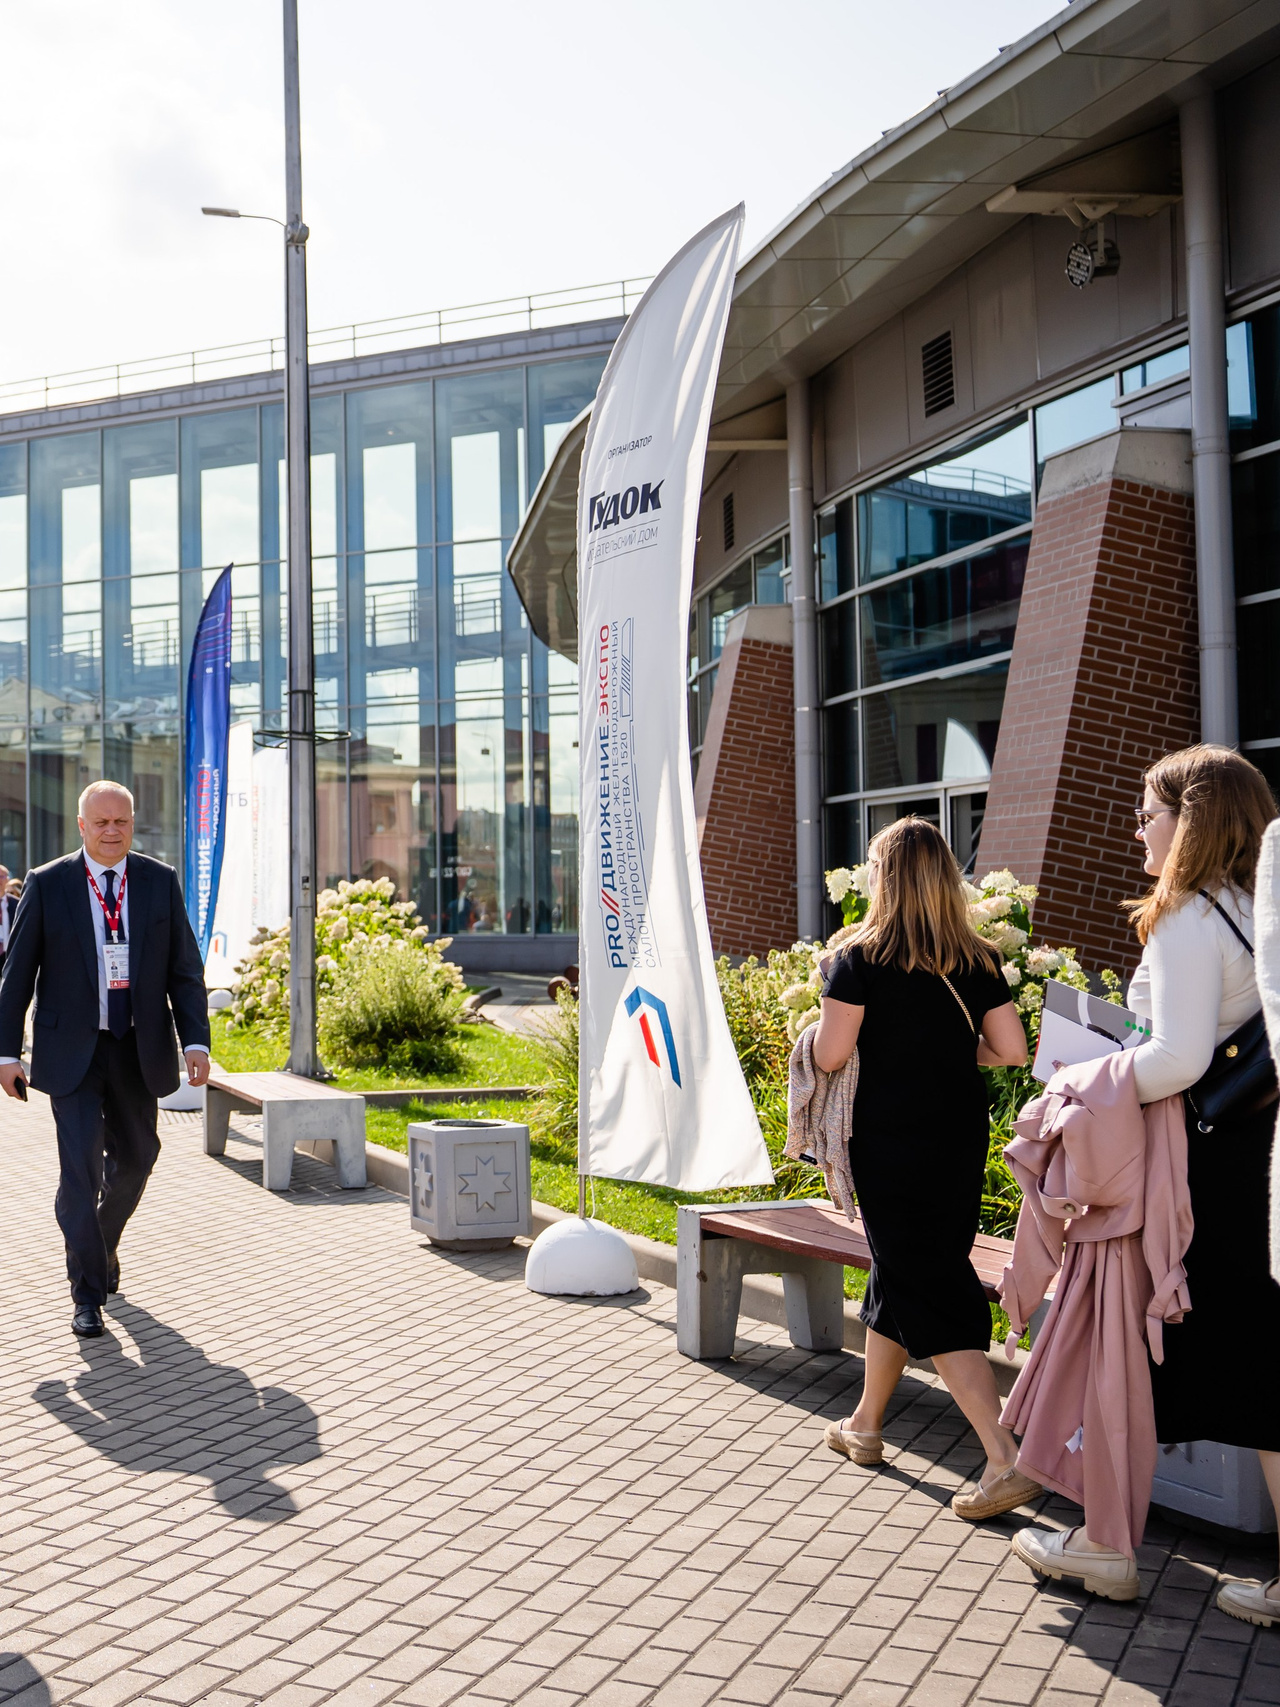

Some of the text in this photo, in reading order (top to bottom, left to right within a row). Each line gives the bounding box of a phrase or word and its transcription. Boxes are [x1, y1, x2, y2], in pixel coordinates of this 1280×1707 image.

[607, 435, 652, 460] ОРГАНИЗАТОР
[611, 620, 643, 968] МЕЖДУНАРОДНЫЙ ЖЕЛЕЗНОДОРОЖНЫЙ
[620, 732, 656, 968] САЛОН ПРОСТРАНСТВА 1520
